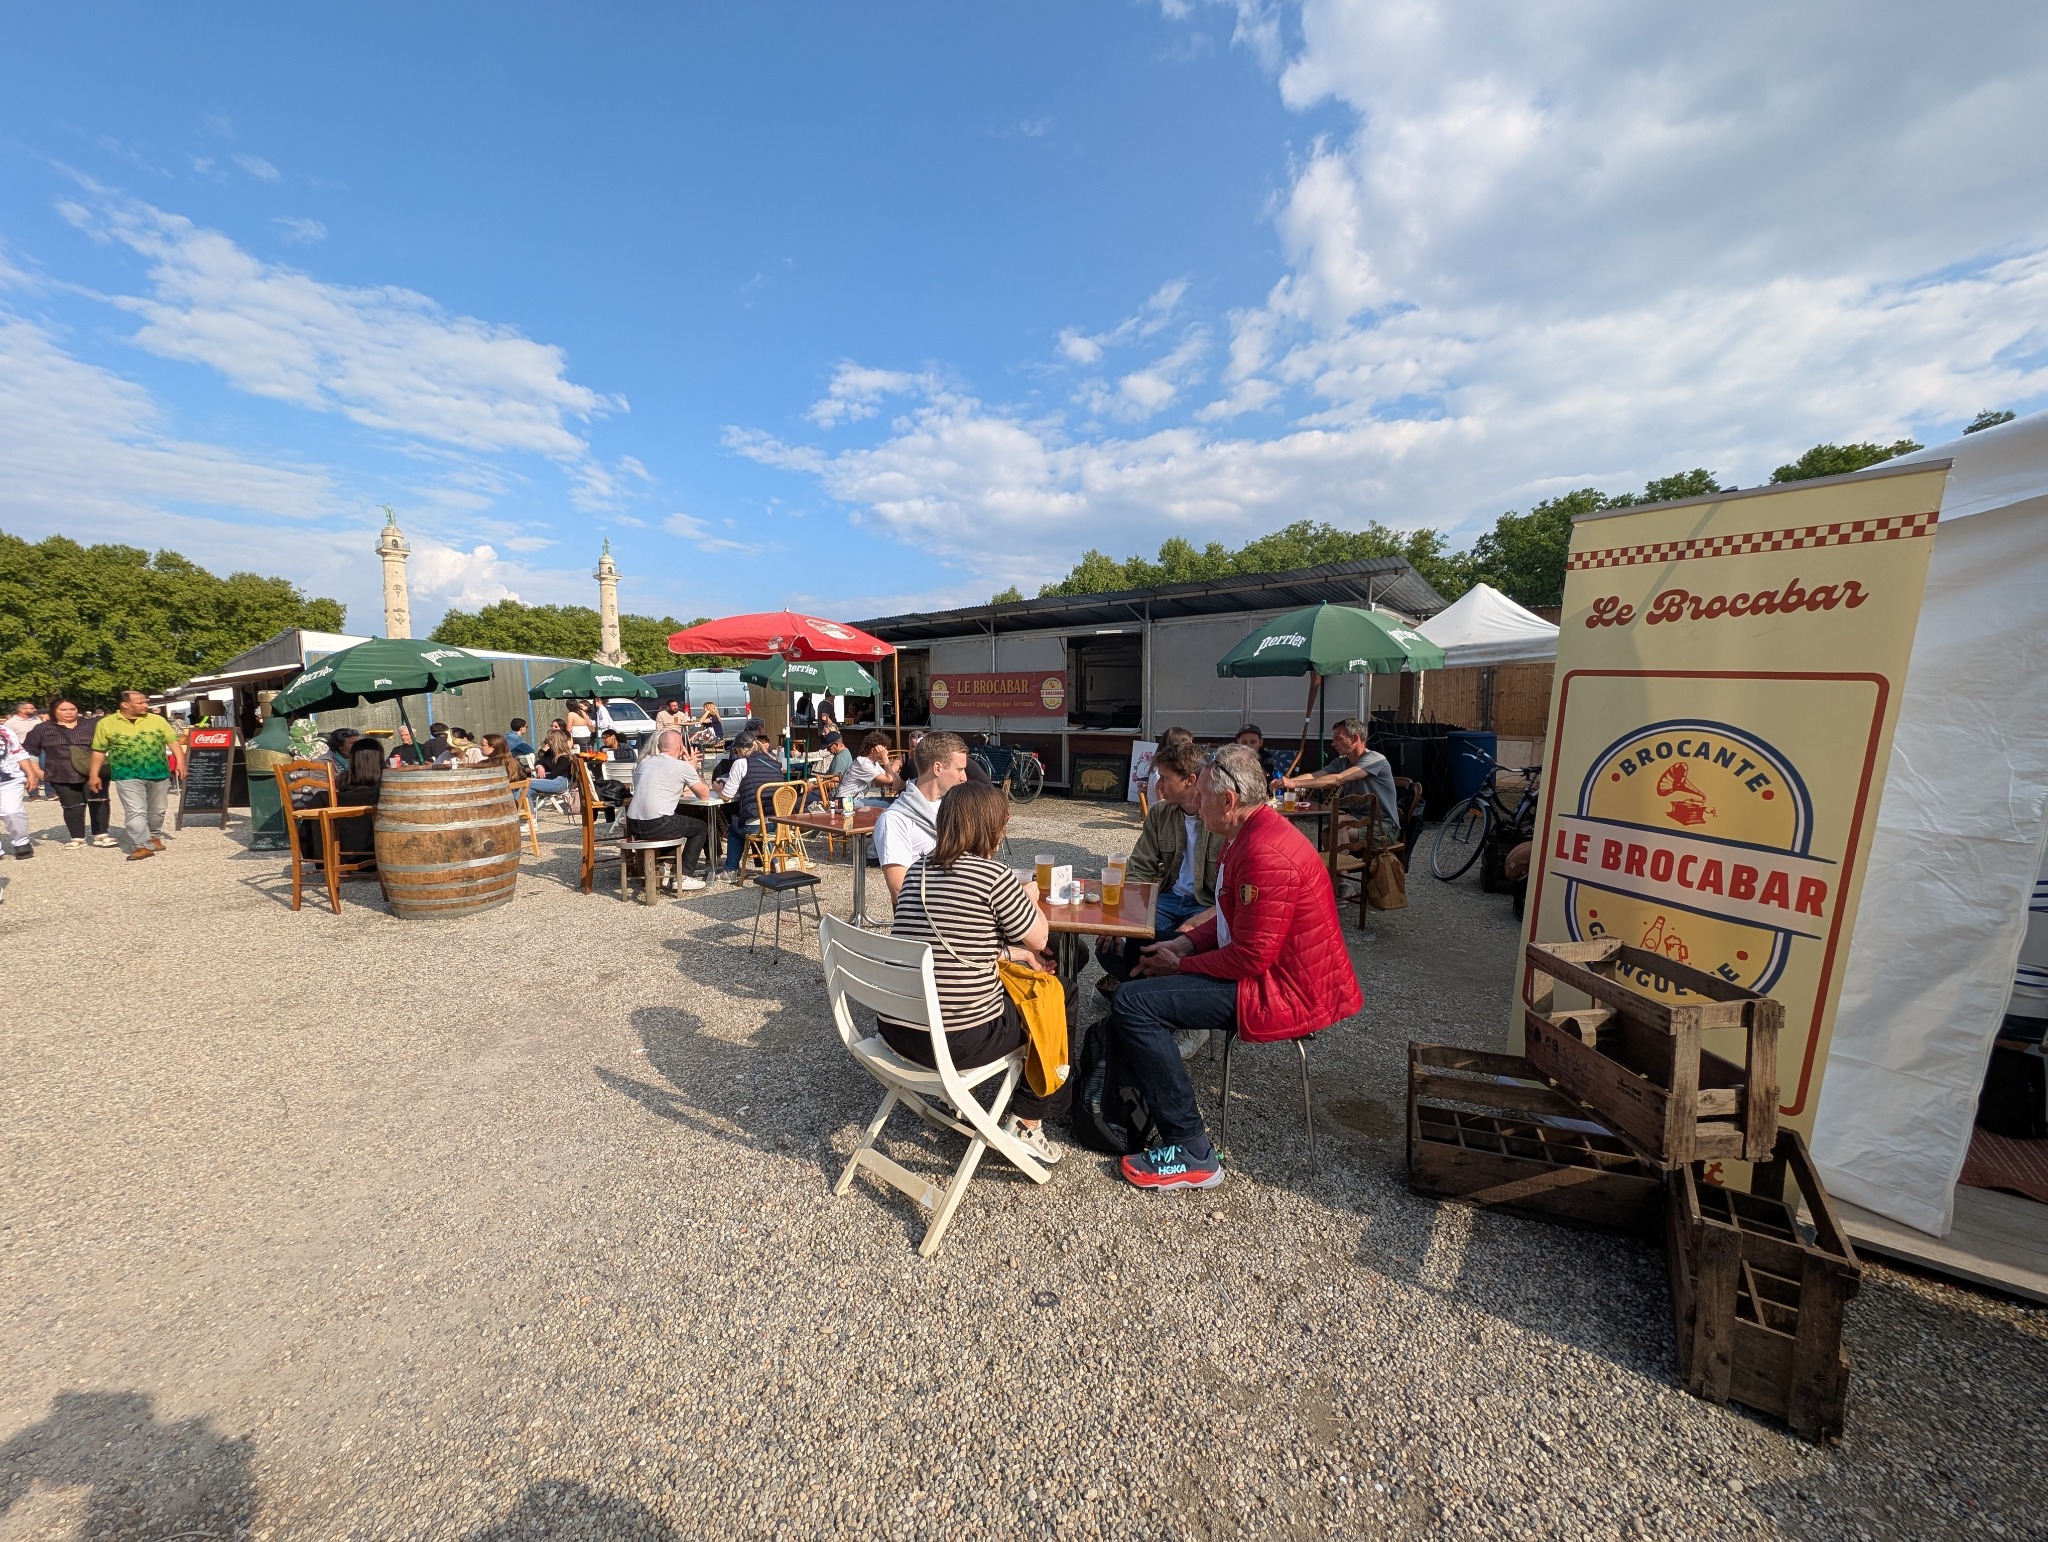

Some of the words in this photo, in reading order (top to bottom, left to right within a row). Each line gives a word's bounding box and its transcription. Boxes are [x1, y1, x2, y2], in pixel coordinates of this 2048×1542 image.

[1585, 595, 1637, 629] Le
[1645, 577, 1870, 625] Brocabar
[957, 680, 971, 694] LE
[973, 679, 1029, 694] BROCABAR
[1618, 739, 1773, 793] BROCANTE
[1554, 829, 1591, 865] LE
[1600, 838, 1828, 918] BROCABAR
[1545, 1036, 1559, 1052] 69
[1158, 1163, 1187, 1176] HOKA
